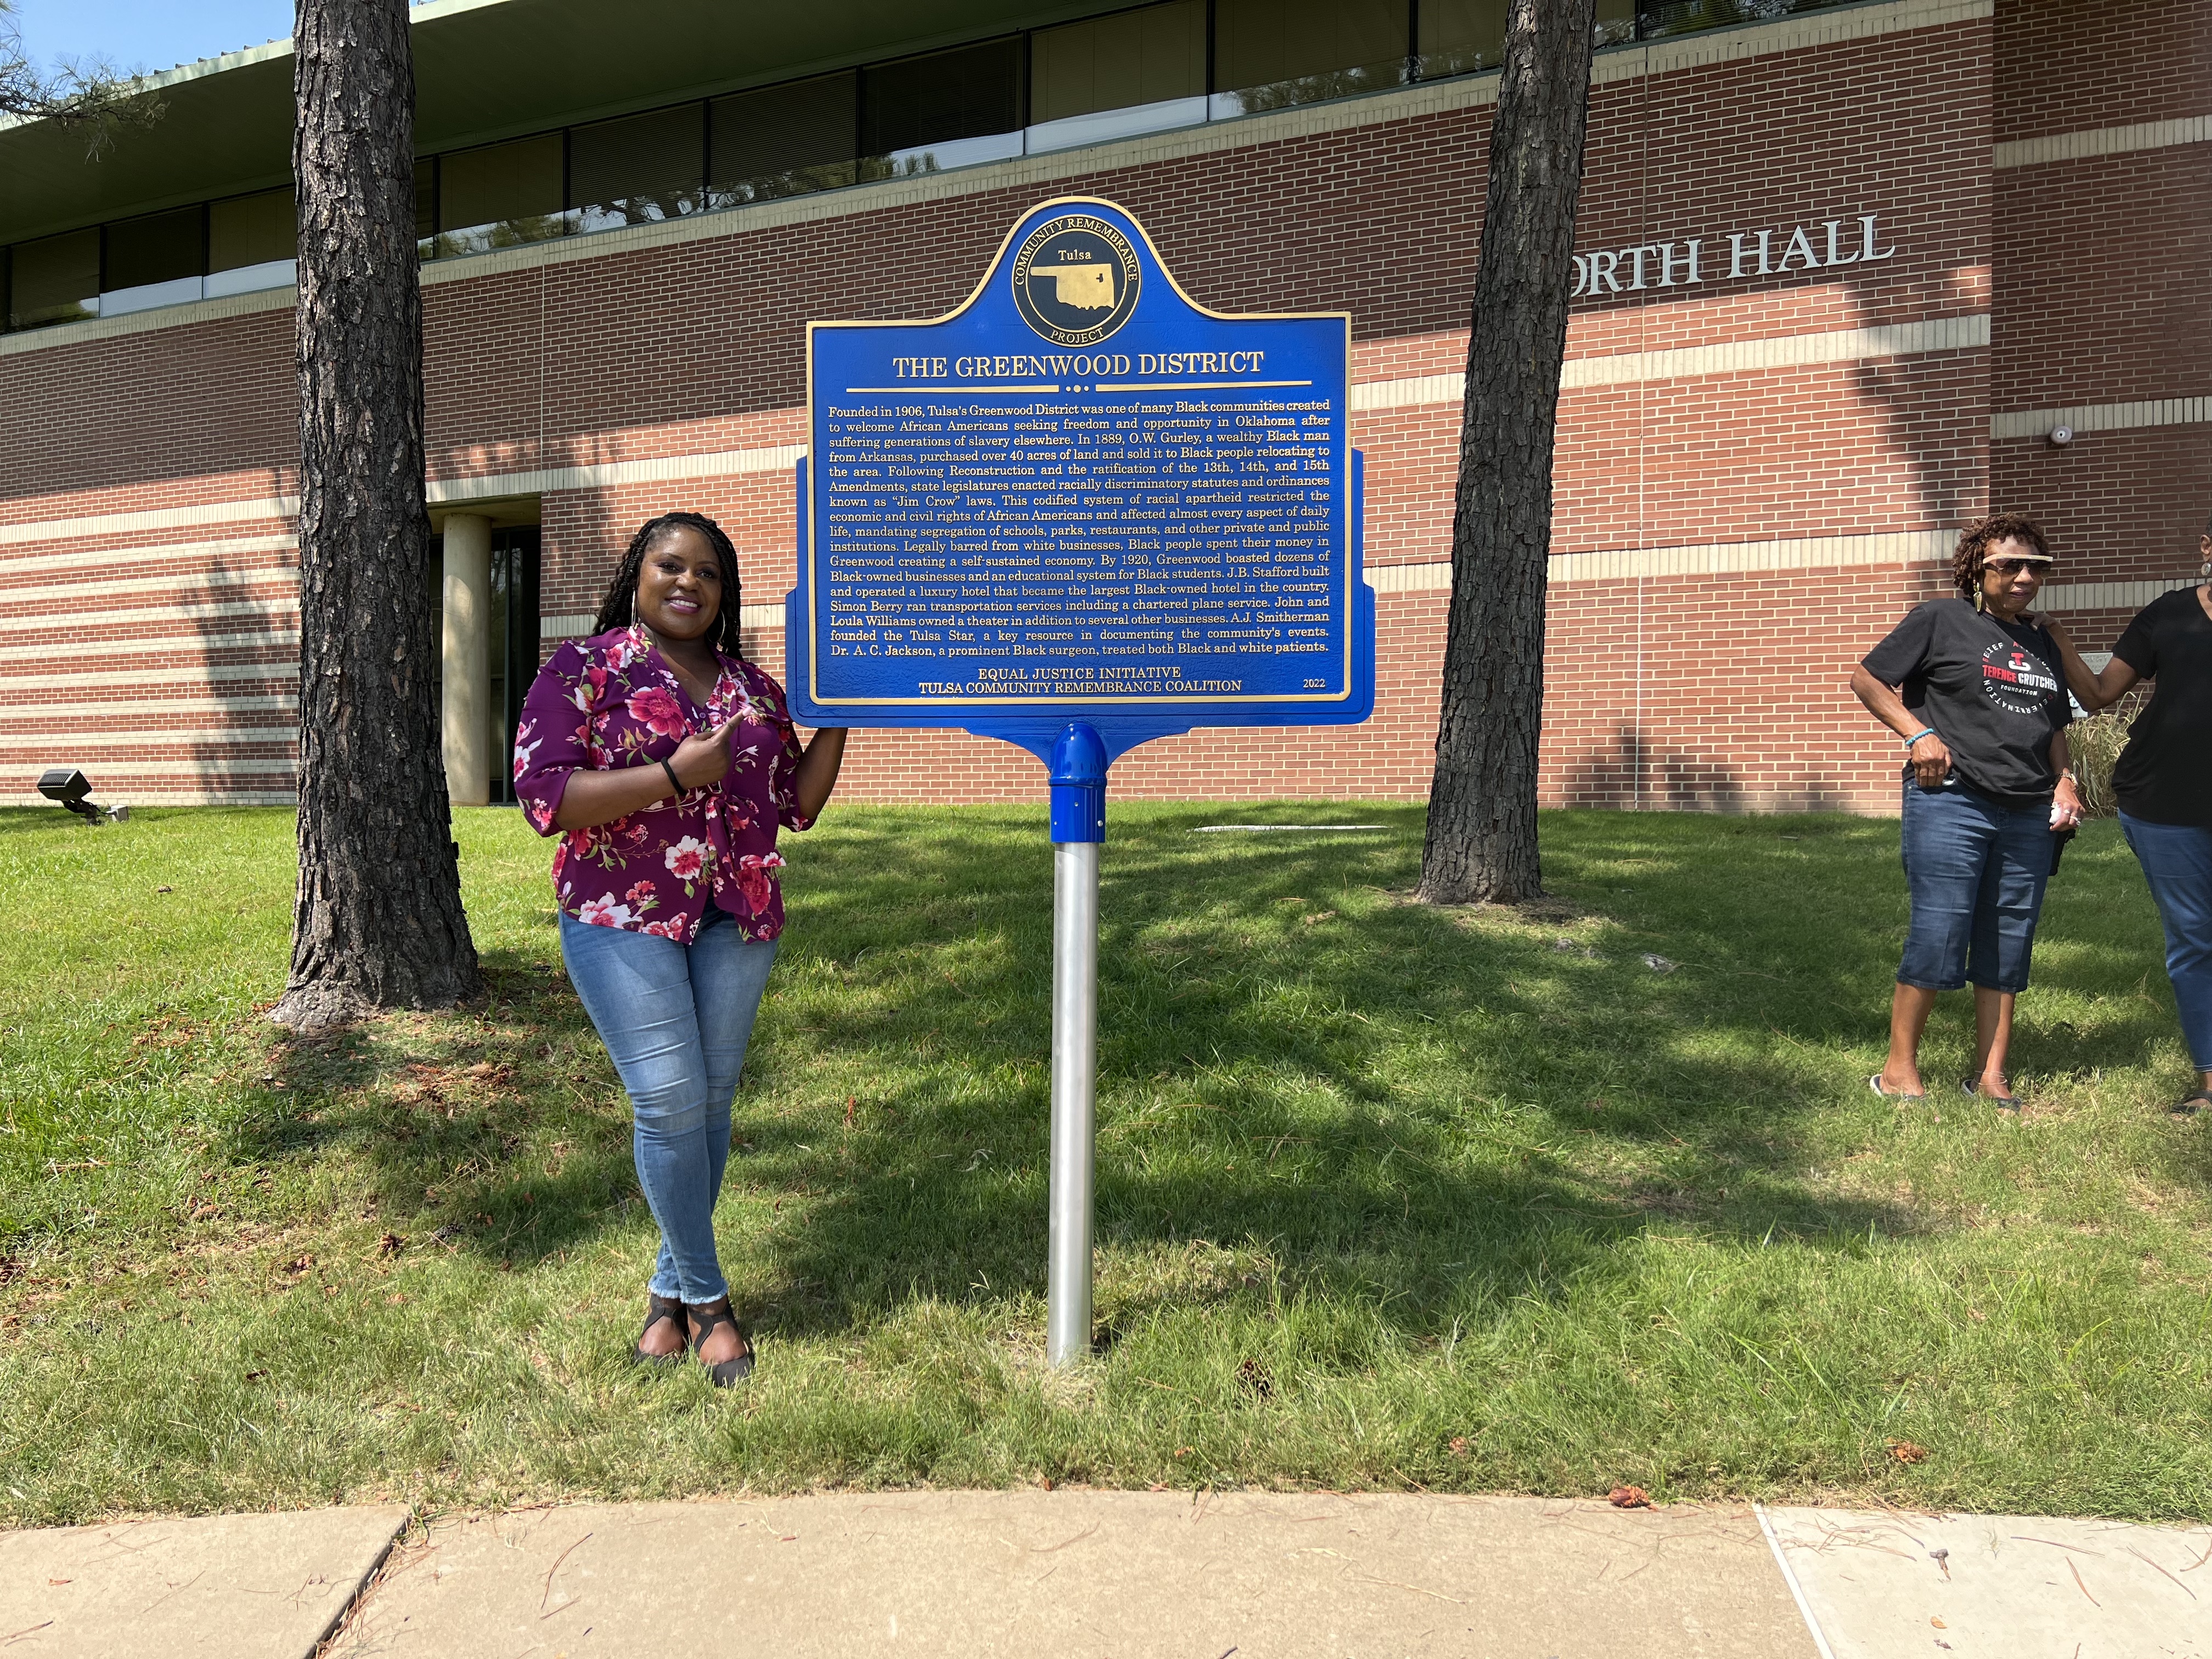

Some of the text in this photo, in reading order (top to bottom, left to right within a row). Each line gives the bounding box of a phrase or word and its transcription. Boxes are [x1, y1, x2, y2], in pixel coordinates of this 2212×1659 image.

[1015, 218, 1138, 285] COMMUNITY REMEMBRANCE
[1057, 248, 1092, 261] Tulsa
[1725, 215, 1896, 279] HALL
[1049, 327, 1104, 344] PROJECT
[892, 350, 1265, 378] THE GREENWOOD DISTRICT
[828, 398, 1331, 419] Founded in 1906, Tulsa's Greenwood District was one of many Black communities created
[828, 414, 1331, 433] to welcome African Americans seeking freedom and opportunity in Oklahoma after
[828, 444, 1330, 464] from Arkansas, purchased over 40 acres of land and sold it to Black people relocating to
[828, 475, 1330, 494] Amendments, state legislatures enacted racially discriminatory statutes and ordinances
[829, 504, 1330, 524] economic and civil rights of African Americans and affected almost every aspect of daily
[830, 535, 1330, 554] institutions. Legally barred from white businesses, Black people spent their money in
[830, 565, 1330, 583] Black-owned businesses and an educational system for Black students. J.B. Stafford built
[830, 595, 1330, 614] Simon Berry ran transportation services including a chartered plane service. John and
[830, 626, 1329, 644] founded the Tulsa Star, a key resource in documenting the community's events.
[831, 640, 1329, 658] Dr. A. C. Jackson, a prominent Black surgeon, treated both Black and white patients.
[978, 666, 1181, 682] EQUAL JUSTICE INITIATIVE
[1302, 678, 1327, 689] 2022
[1982, 664, 2058, 692] TERENCE CRUTCHER
[918, 679, 1243, 695] TULSA COMMUNITY REMEMBRANCE COALITION
[2000, 684, 2038, 696] FOUNDATION
